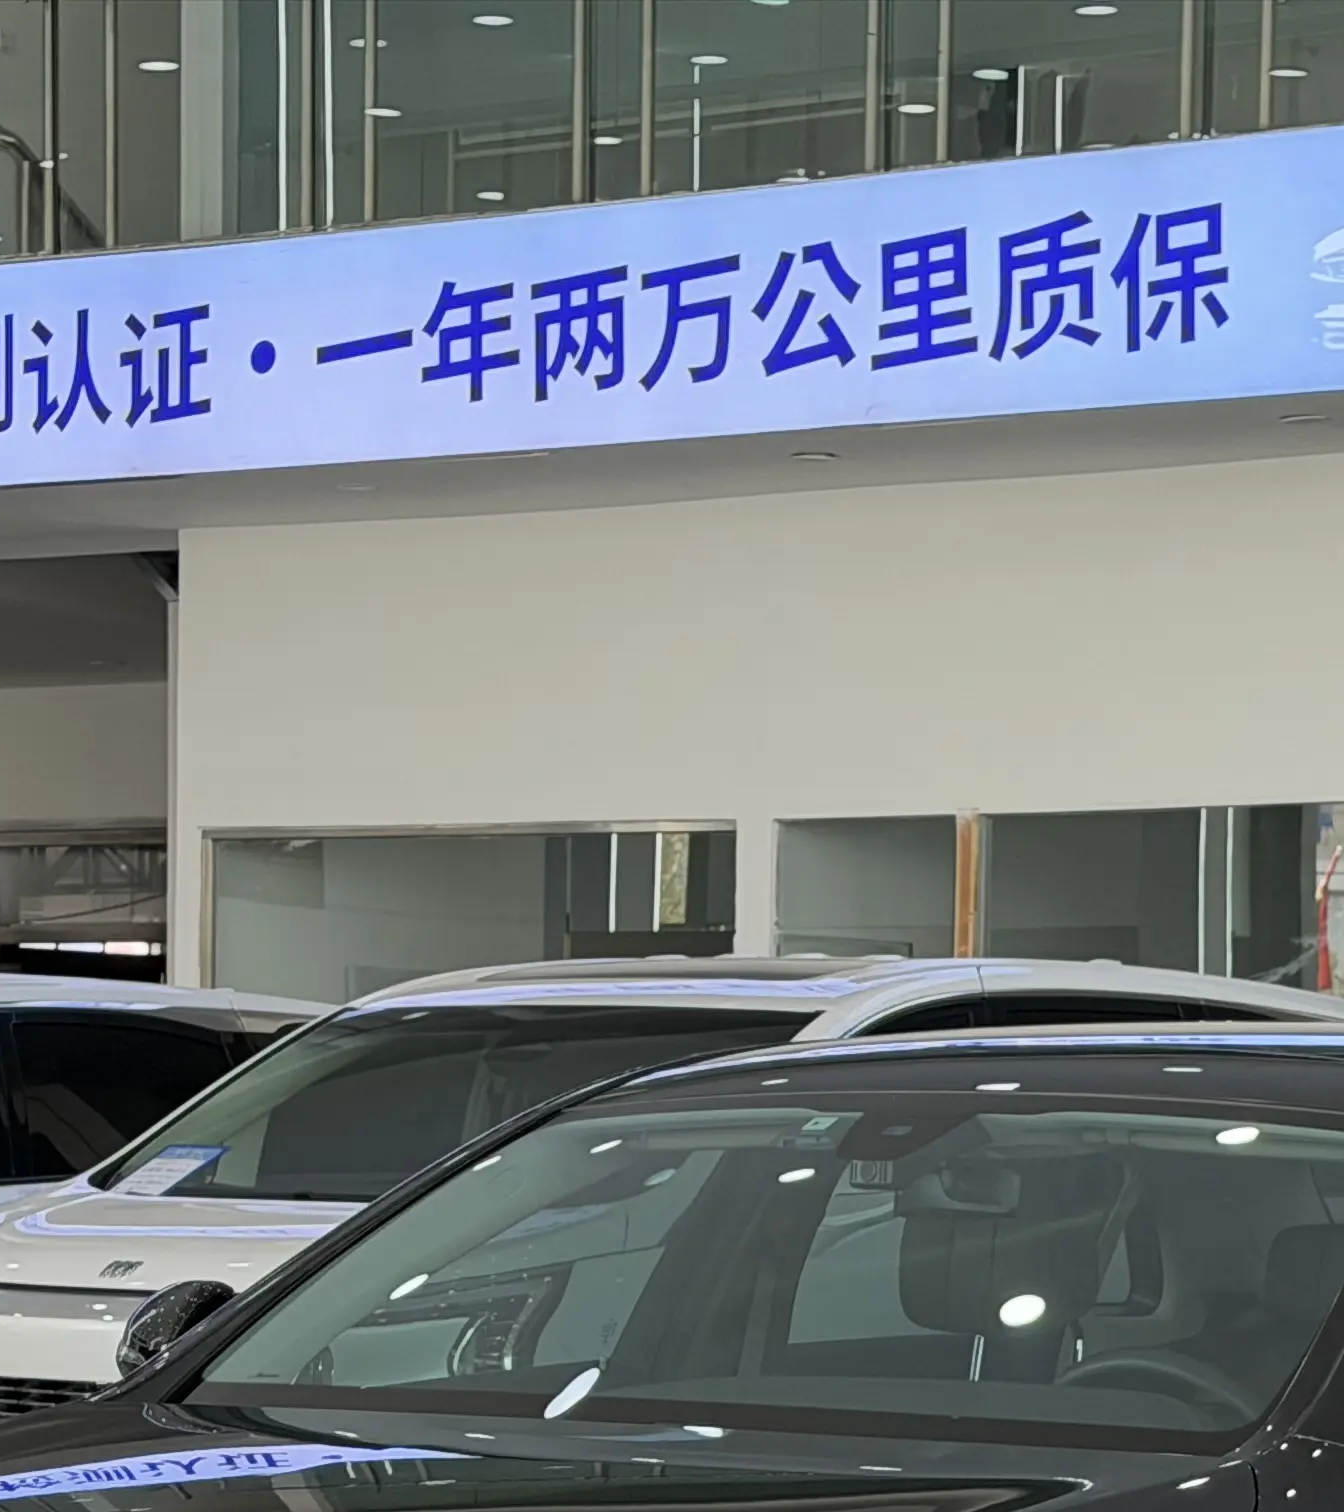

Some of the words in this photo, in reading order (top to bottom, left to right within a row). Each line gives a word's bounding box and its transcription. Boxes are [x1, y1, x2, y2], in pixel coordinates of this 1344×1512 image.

[316, 202, 1230, 403] 一年两万公里质保
